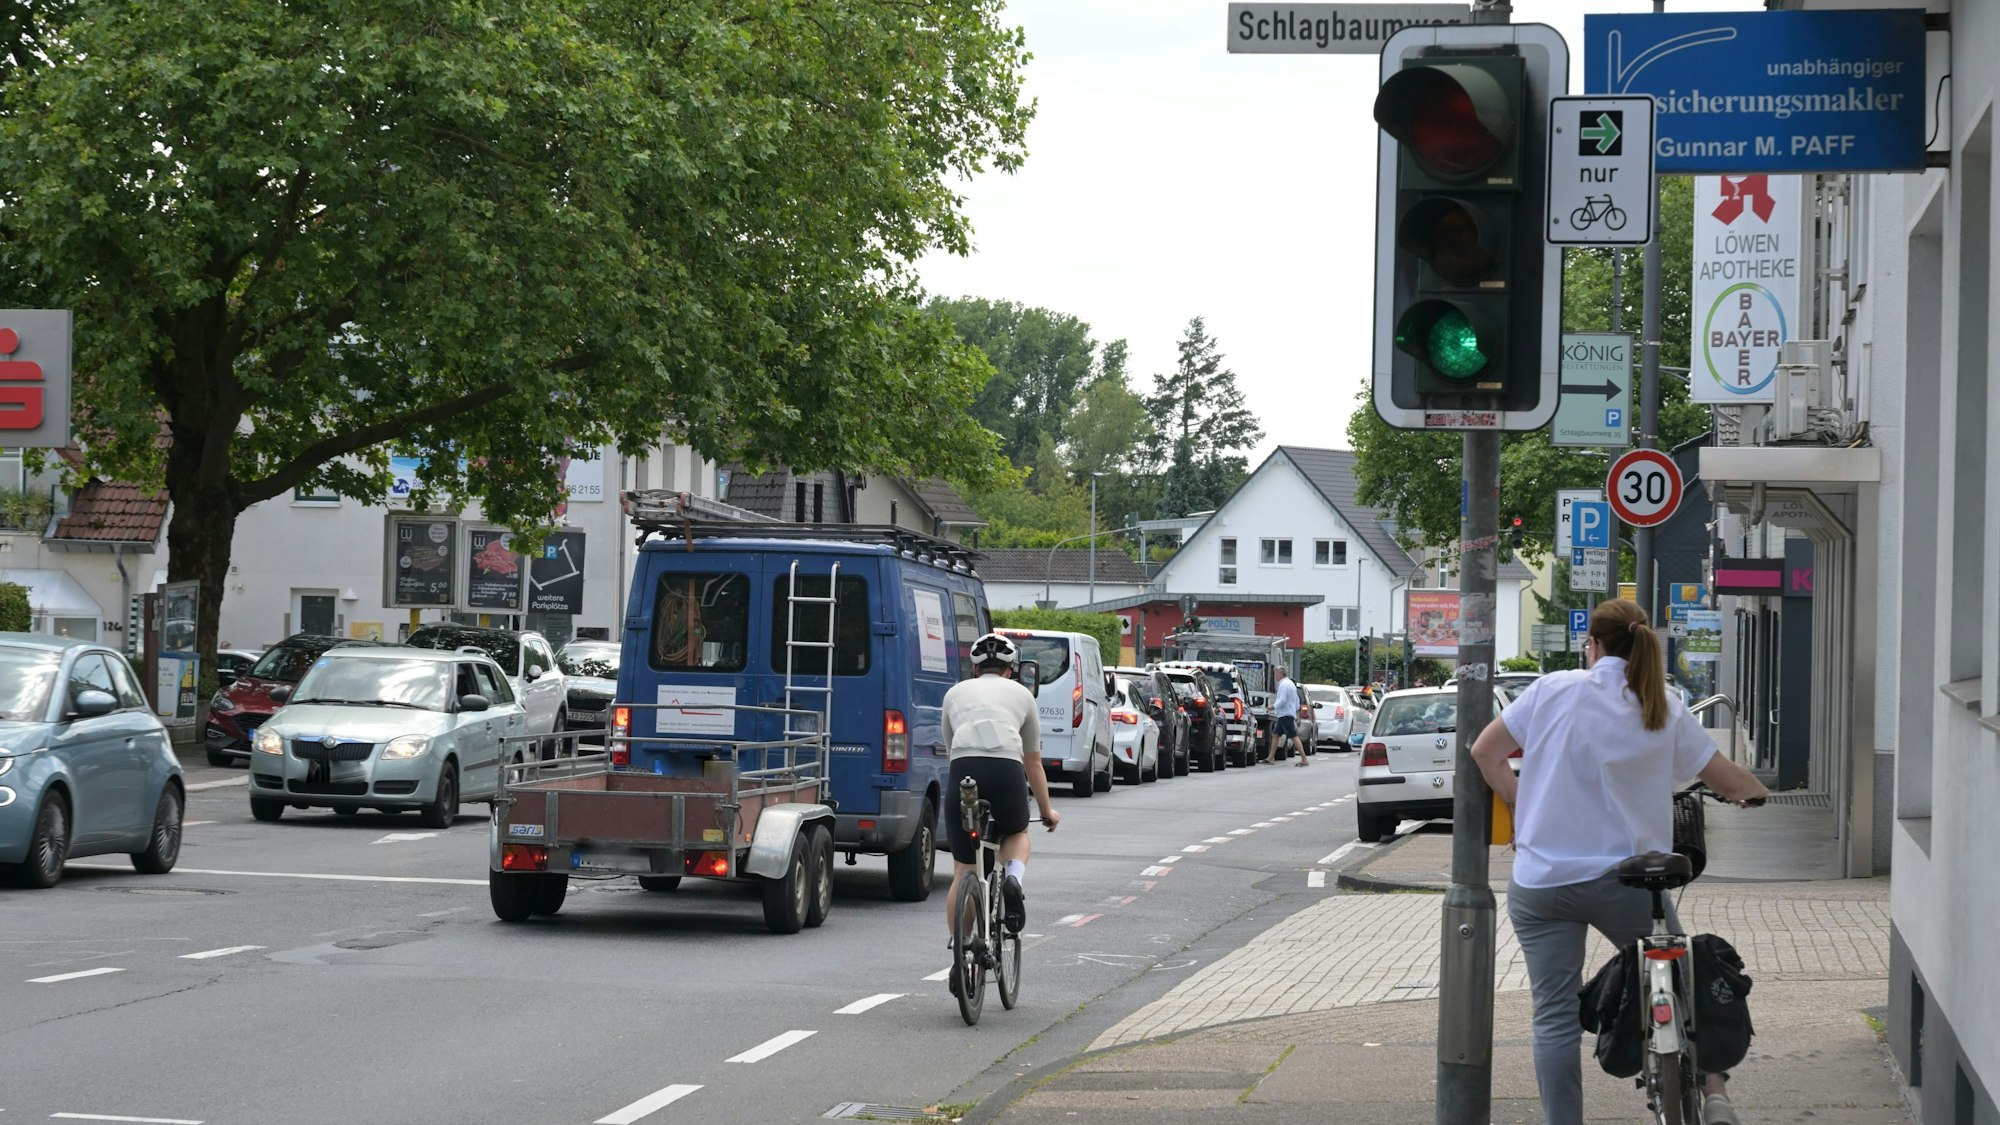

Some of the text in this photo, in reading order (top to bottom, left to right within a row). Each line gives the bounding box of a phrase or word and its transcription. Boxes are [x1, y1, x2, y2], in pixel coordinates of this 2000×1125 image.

[1239, 10, 1461, 48] Schlagbaum
[1767, 59, 1904, 78] unabhängiger
[1655, 88, 1905, 119] sicherungsmakler
[1656, 135, 1855, 157] Gunnar M. PAFF
[1579, 166, 1619, 183] nur
[1715, 230, 1779, 254] LÖWEN
[1699, 258, 1795, 280] APOTHEKE
[1711, 330, 1780, 348] BAYER
[1737, 293, 1752, 385] BAYER
[1562, 342, 1623, 361] KÖNIG
[1561, 363, 1623, 371] BESTATTUNGEN
[1608, 411, 1619, 425] P
[1560, 429, 1612, 438] Schlagbaumweg
[1623, 471, 1665, 504] 30
[1580, 507, 1600, 541] P
[532, 602, 568, 611] Parkplätze
[537, 594, 564, 602] weitere
[1574, 612, 1586, 629] P
[1040, 707, 1065, 716] 97630
